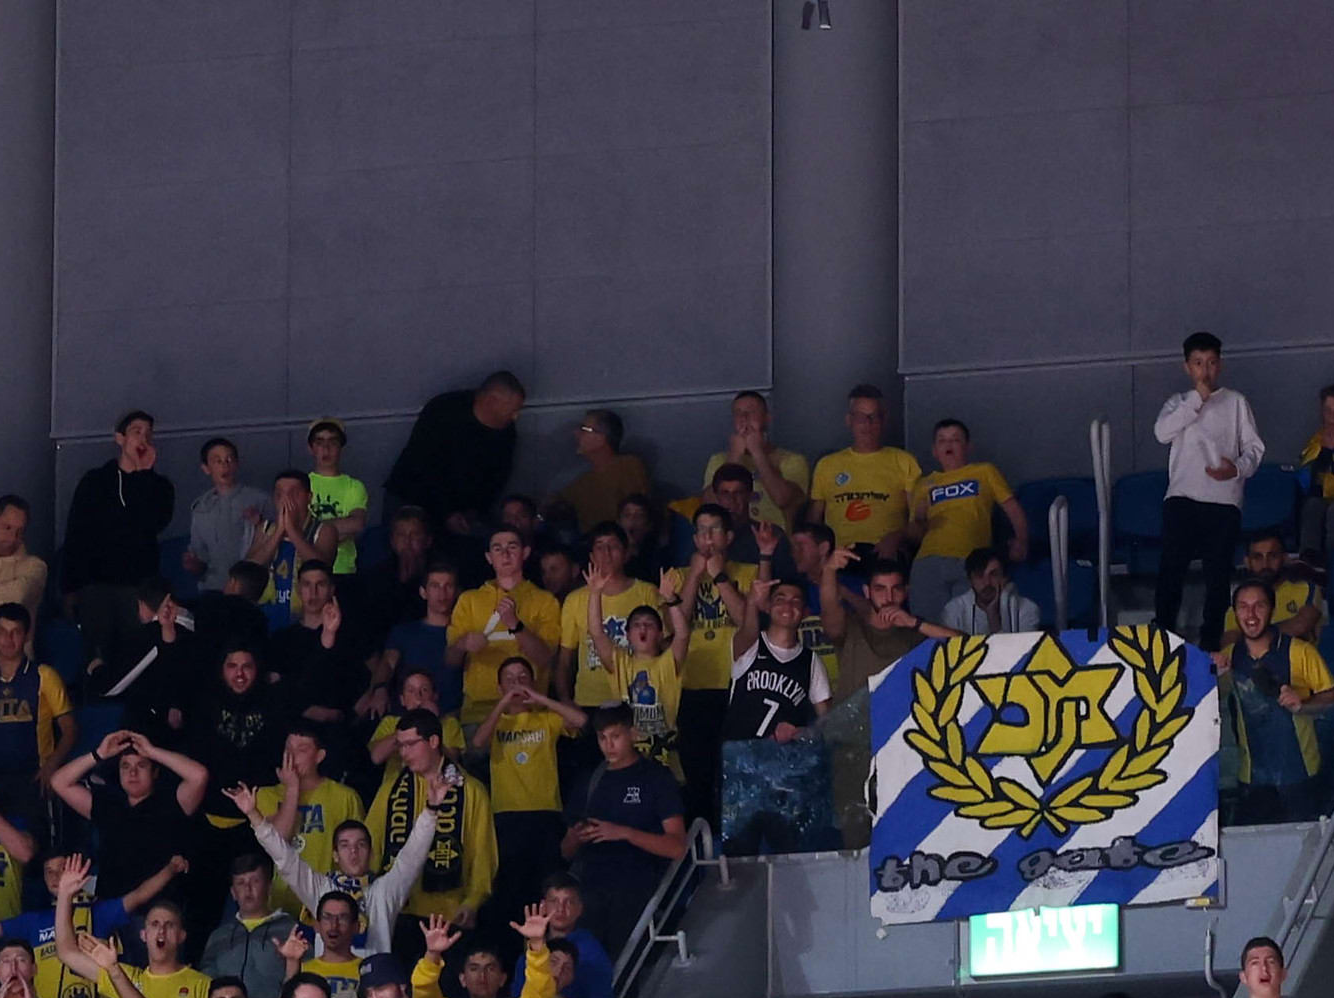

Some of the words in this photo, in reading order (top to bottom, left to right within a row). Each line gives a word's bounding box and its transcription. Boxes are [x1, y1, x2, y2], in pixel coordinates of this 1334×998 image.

[932, 481, 976, 502] FOX
[746, 669, 807, 707] BROOKLYN
[757, 697, 780, 737] 7
[873, 850, 999, 892] the
[1018, 835, 1216, 883] gate
